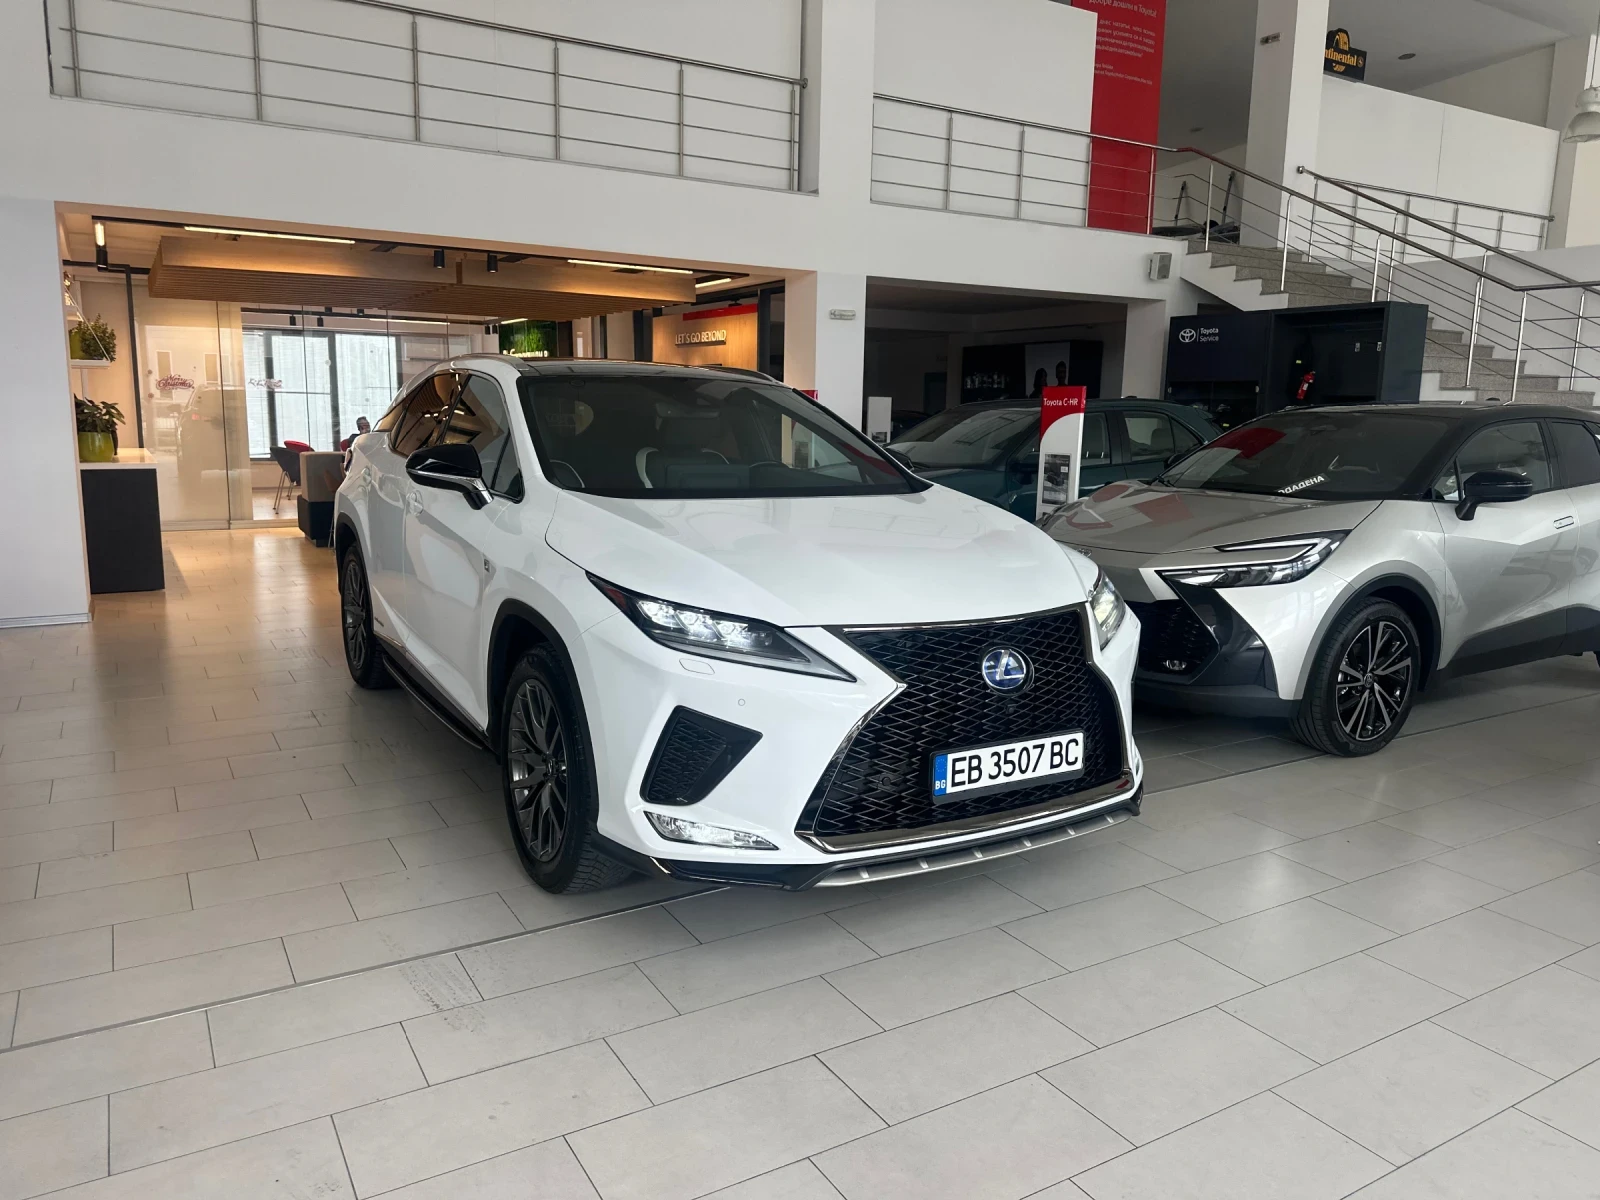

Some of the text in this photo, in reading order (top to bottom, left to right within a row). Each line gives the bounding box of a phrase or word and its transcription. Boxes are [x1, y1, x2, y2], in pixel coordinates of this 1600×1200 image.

[1112, 0, 1133, 10] дошли
[691, 333, 700, 342] GO
[701, 329, 726, 342] BEYOND
[1200, 327, 1219, 335] Toyota
[1043, 398, 1079, 407] Toyota C-HR
[951, 738, 1079, 788] EB 3507 BC
[935, 780, 946, 790] BG
